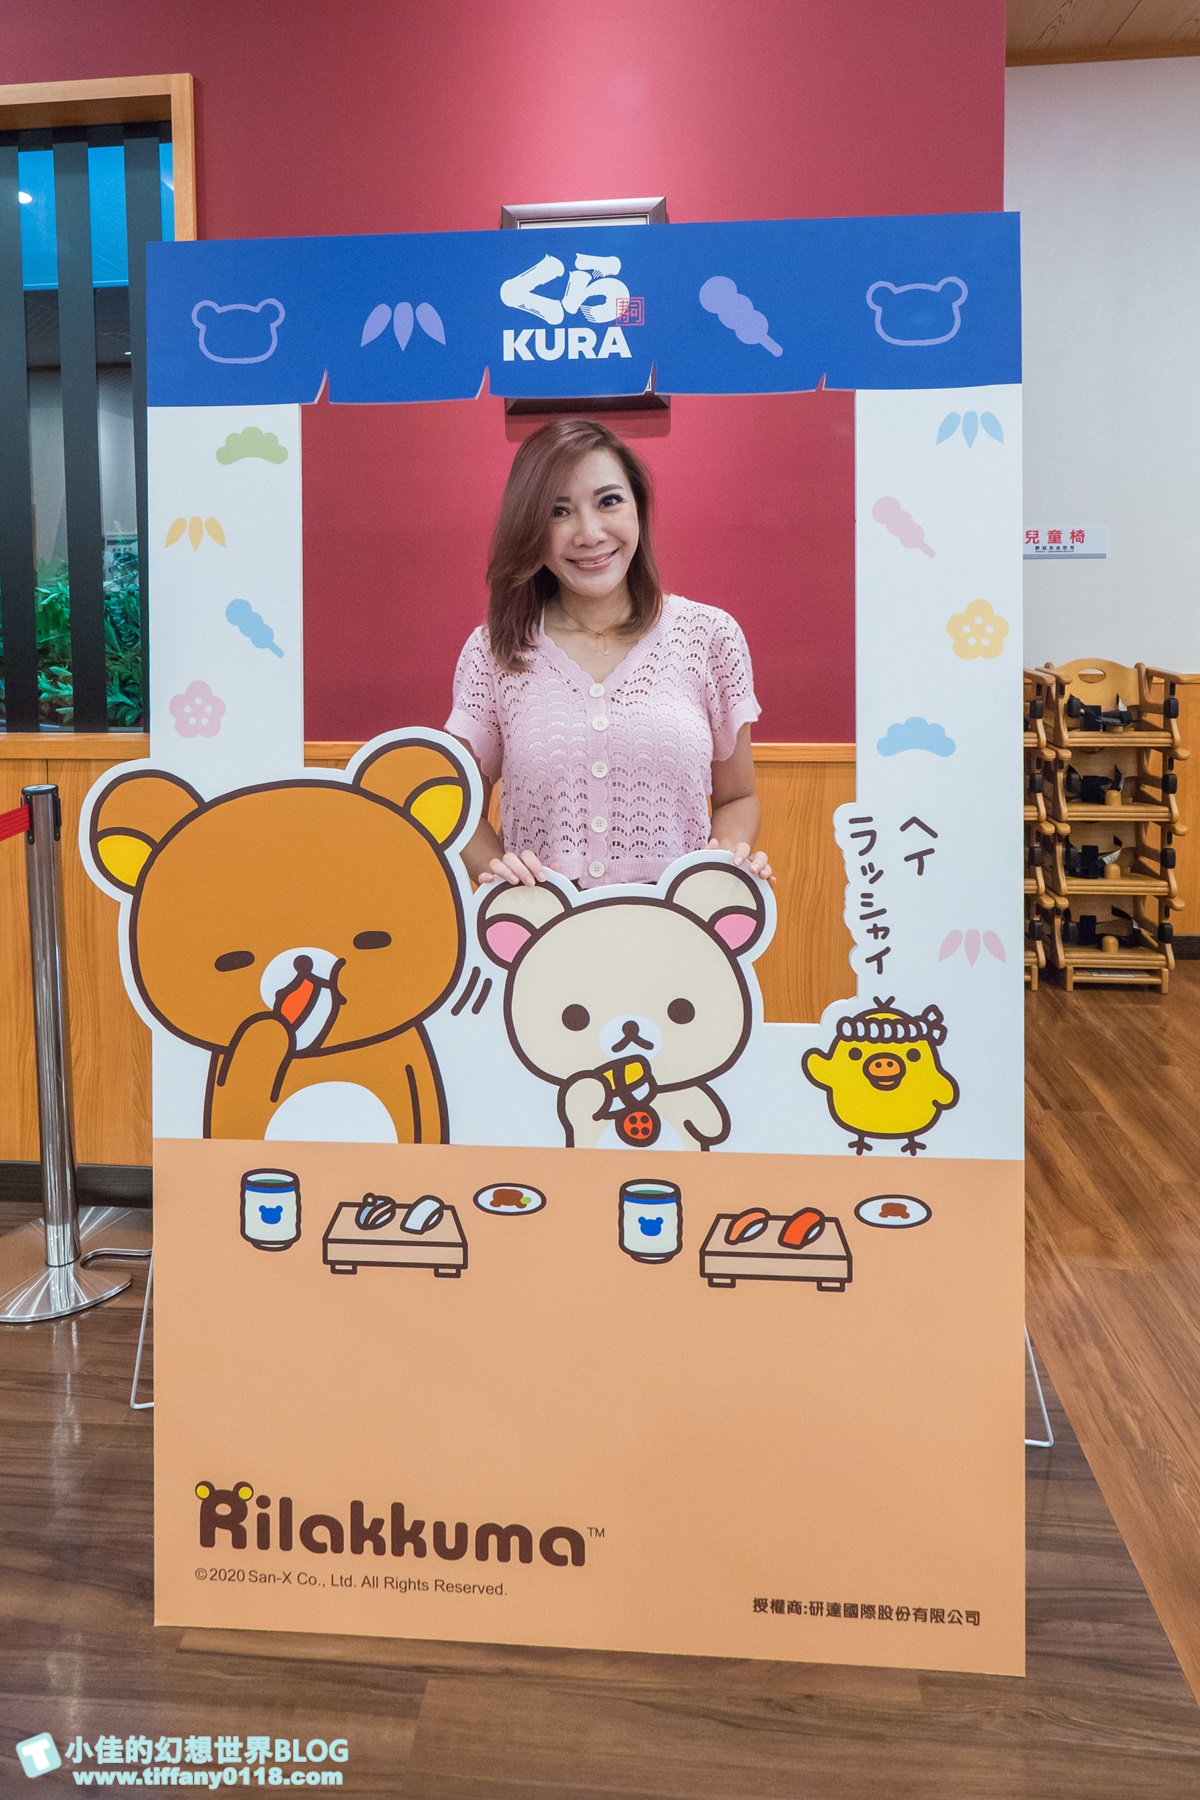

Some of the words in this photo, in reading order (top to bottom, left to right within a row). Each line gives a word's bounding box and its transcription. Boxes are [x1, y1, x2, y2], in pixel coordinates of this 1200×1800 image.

[503, 326, 632, 361] KURA
[1025, 529, 1085, 544] 兒童椅
[899, 816, 938, 876] ヘイ
[848, 816, 891, 975] ラッシャイ
[195, 1481, 586, 1567] Rilakkuma
[248, 1570, 293, 1585] San-X
[297, 1572, 326, 1588] Co.,
[331, 1573, 357, 1588] Ltd.
[361, 1575, 380, 1590] All
[384, 1577, 430, 1594] Rights
[434, 1578, 508, 1596] Reserved.
